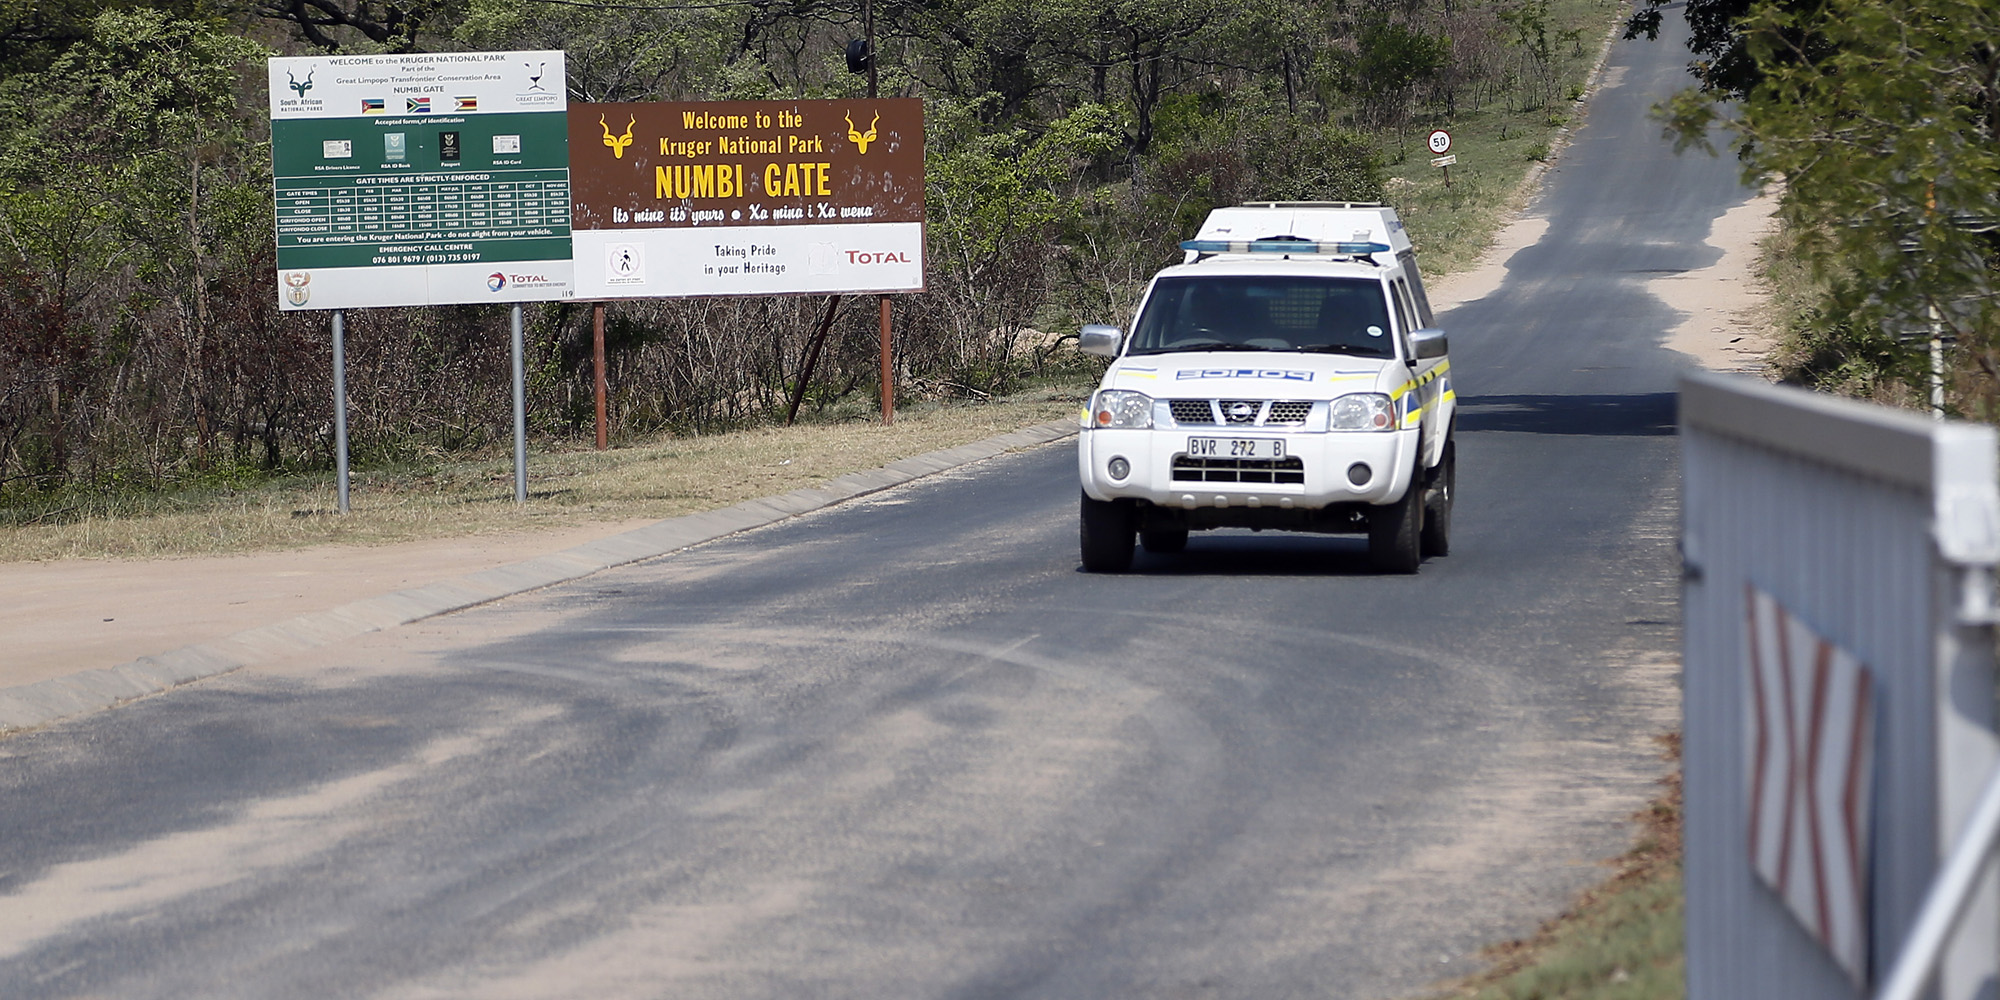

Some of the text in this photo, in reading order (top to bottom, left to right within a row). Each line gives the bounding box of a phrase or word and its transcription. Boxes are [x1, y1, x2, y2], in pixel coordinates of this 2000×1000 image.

[358, 77, 388, 85] Limpopo
[682, 110, 803, 130] Welcome to the
[660, 135, 823, 159] Kruger National Park
[1433, 137, 1446, 147] 50
[655, 162, 831, 199] NUMBI GATE
[612, 206, 629, 223] Its
[634, 208, 665, 222] mine
[691, 208, 725, 226] yours
[748, 202, 874, 220] Xa mina i Xa wena
[426, 254, 446, 263] (013)
[714, 245, 776, 258] Taking Pride
[845, 250, 911, 264] TOTAL
[704, 262, 786, 276] in your Heritage
[1191, 440, 1281, 456] BVR 272 B
